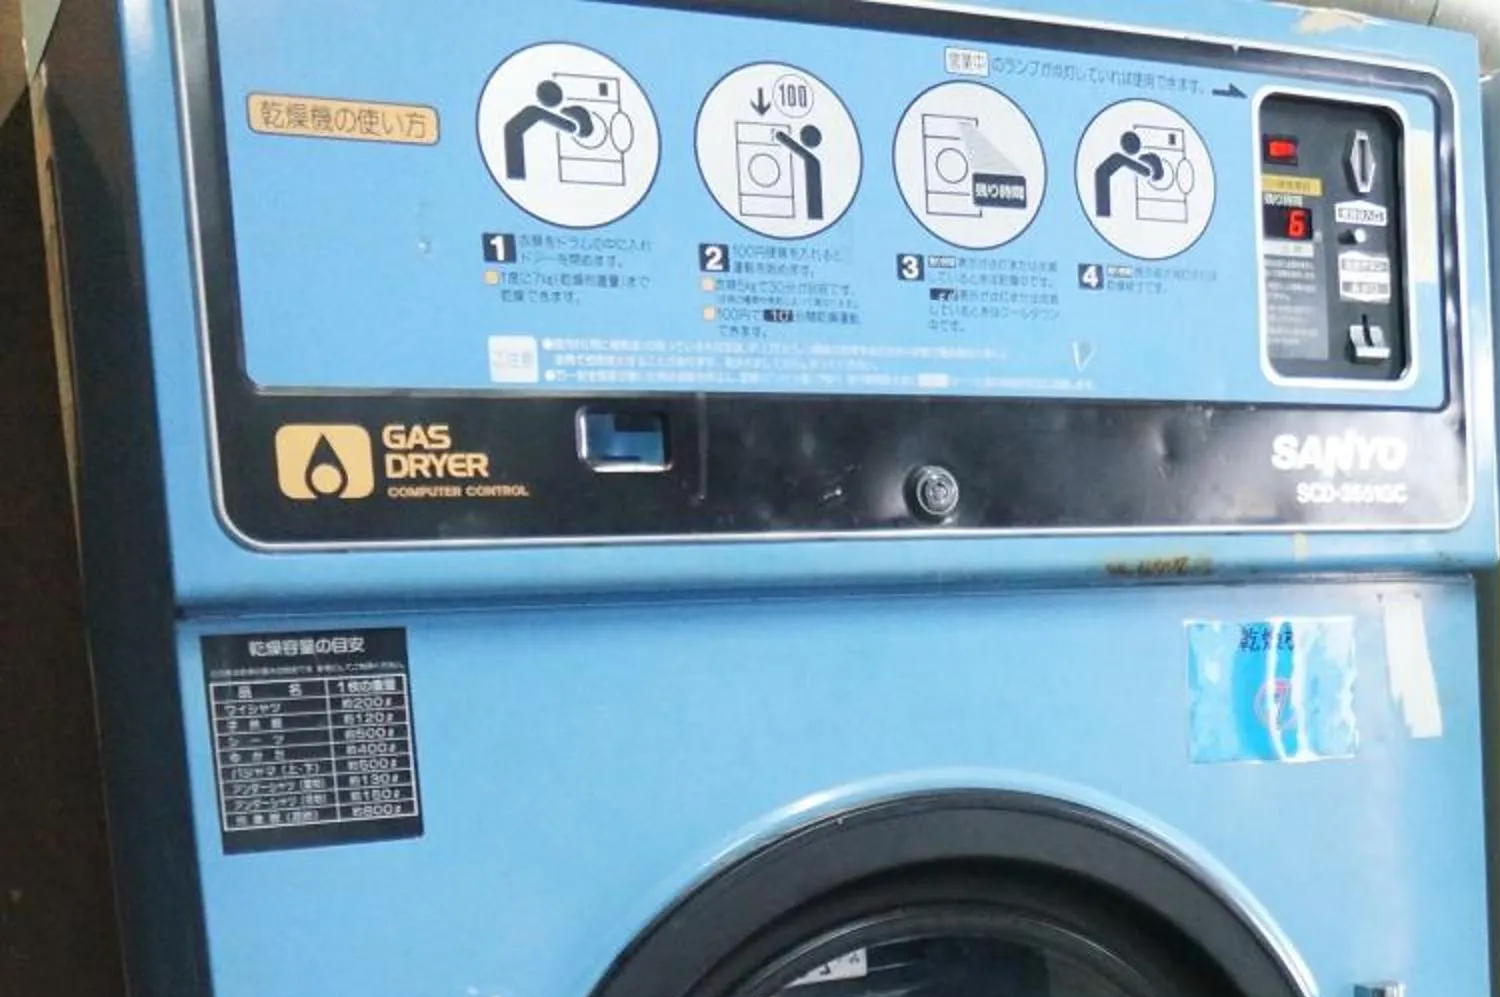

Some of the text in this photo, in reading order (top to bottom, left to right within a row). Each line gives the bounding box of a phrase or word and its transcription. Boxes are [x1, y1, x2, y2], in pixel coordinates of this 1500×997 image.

[779, 84, 807, 108] 100
[260, 100, 427, 139] 乾燥機の使い方
[1287, 207, 1307, 239] 6
[490, 236, 506, 261] 1
[705, 246, 724, 271] 2
[901, 256, 920, 280] 3
[1082, 264, 1100, 288] 4
[382, 424, 452, 449] GAS
[385, 452, 490, 479] DRYER
[1271, 429, 1408, 477] SANYO
[387, 484, 530, 498] COMPUTER CONTROL
[248, 637, 365, 657] 乾燥容量の目安
[224, 702, 282, 717] ワイシャツ
